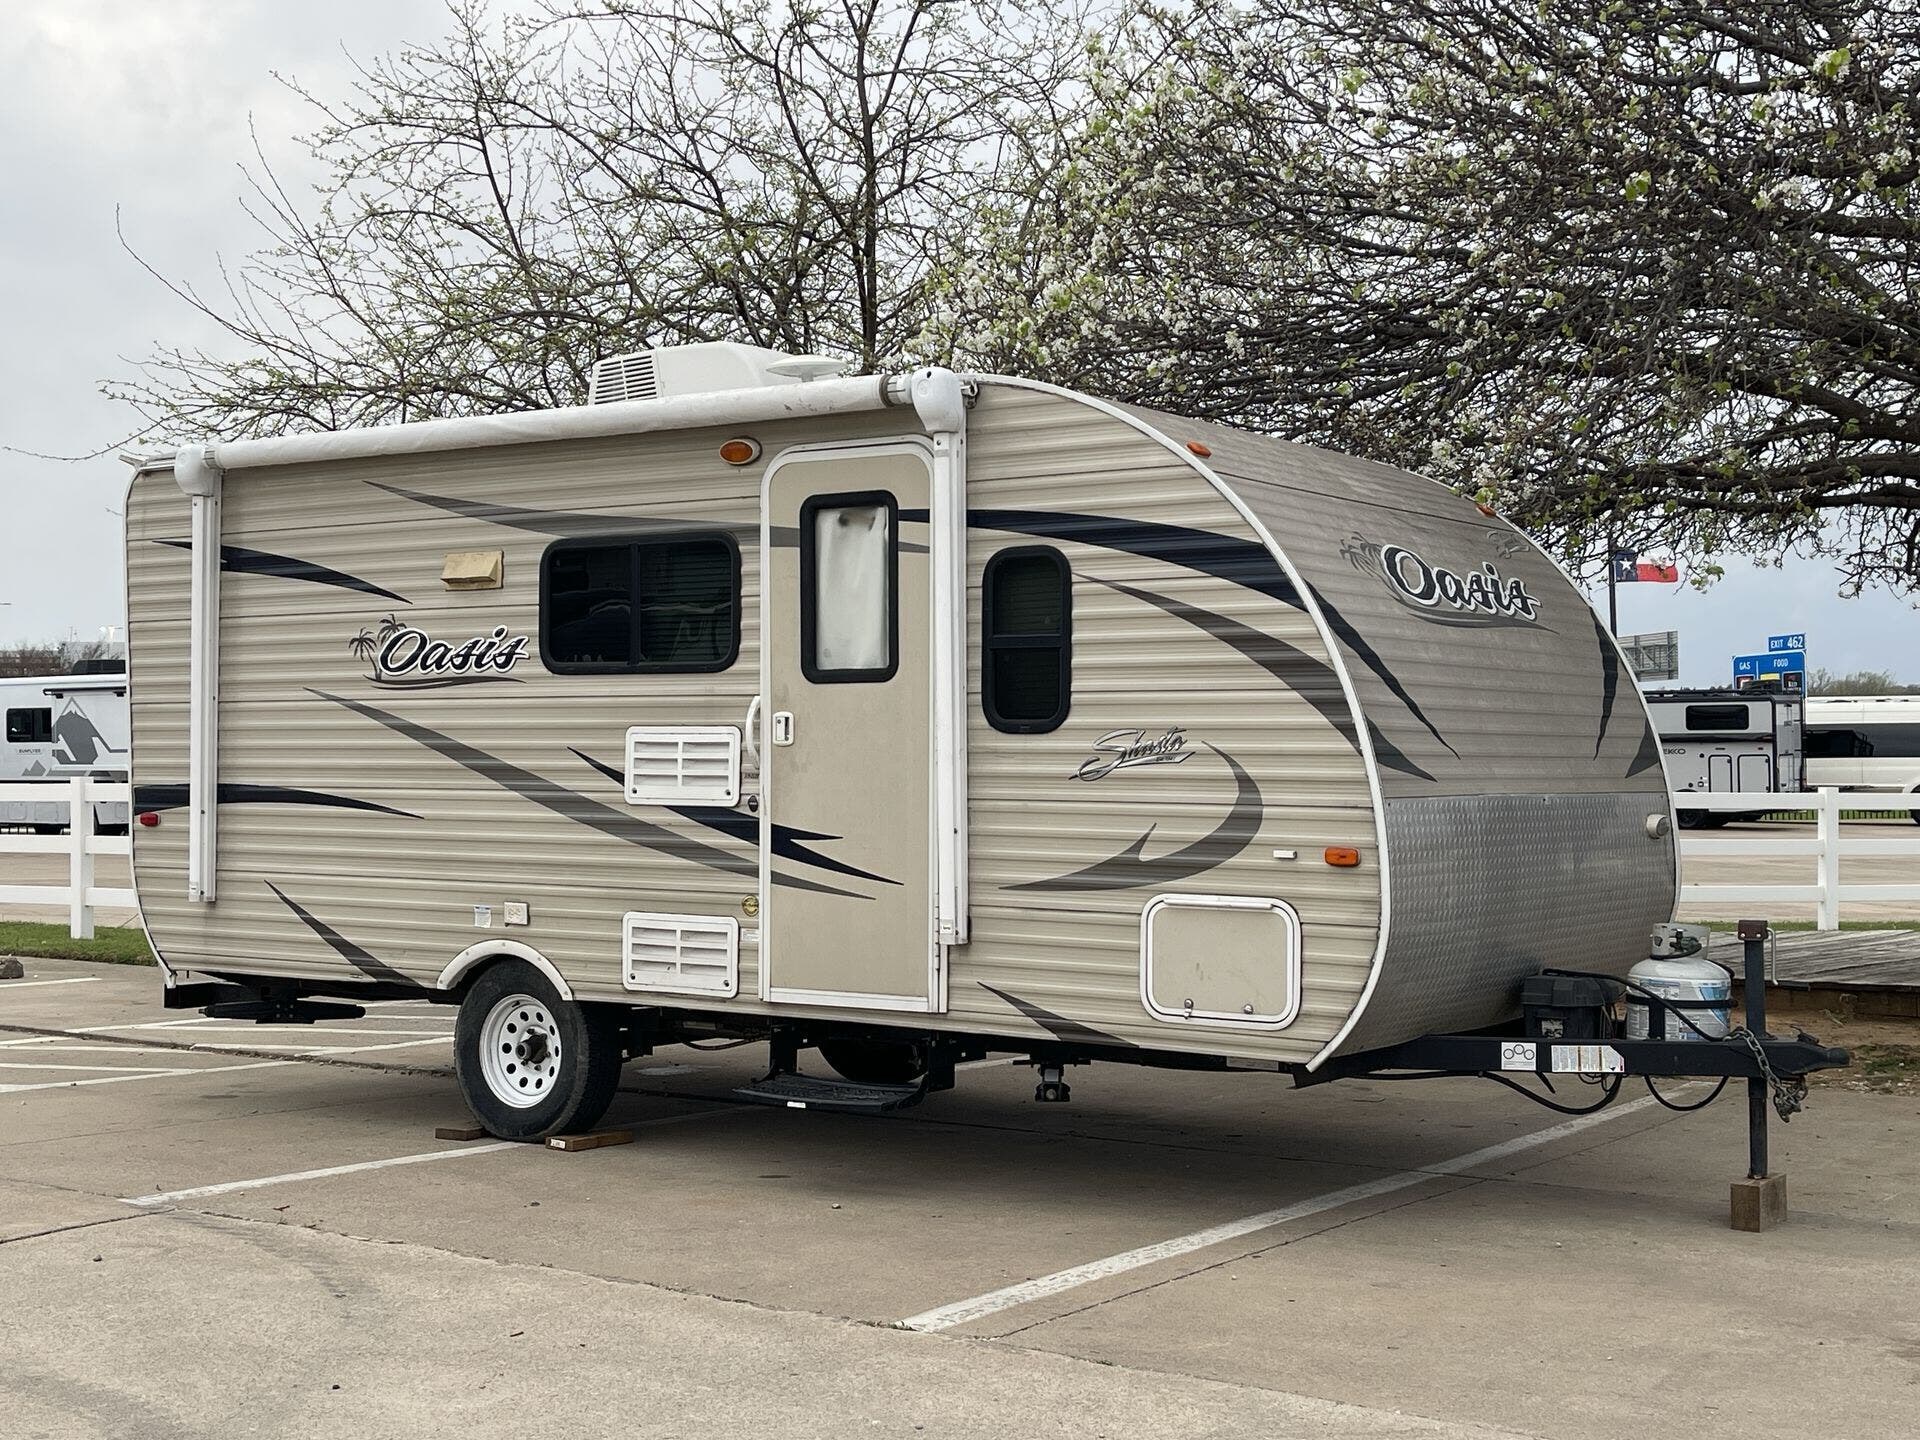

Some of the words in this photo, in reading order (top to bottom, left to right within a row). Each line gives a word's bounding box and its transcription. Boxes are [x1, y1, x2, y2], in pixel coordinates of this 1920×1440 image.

[1381, 543, 1543, 620] Oasis
[1770, 639, 1784, 649] EXIT
[1787, 635, 1804, 649] 462
[378, 624, 531, 676] Oasis
[1739, 661, 1751, 671] GAS
[1773, 658, 1789, 668] FOOD
